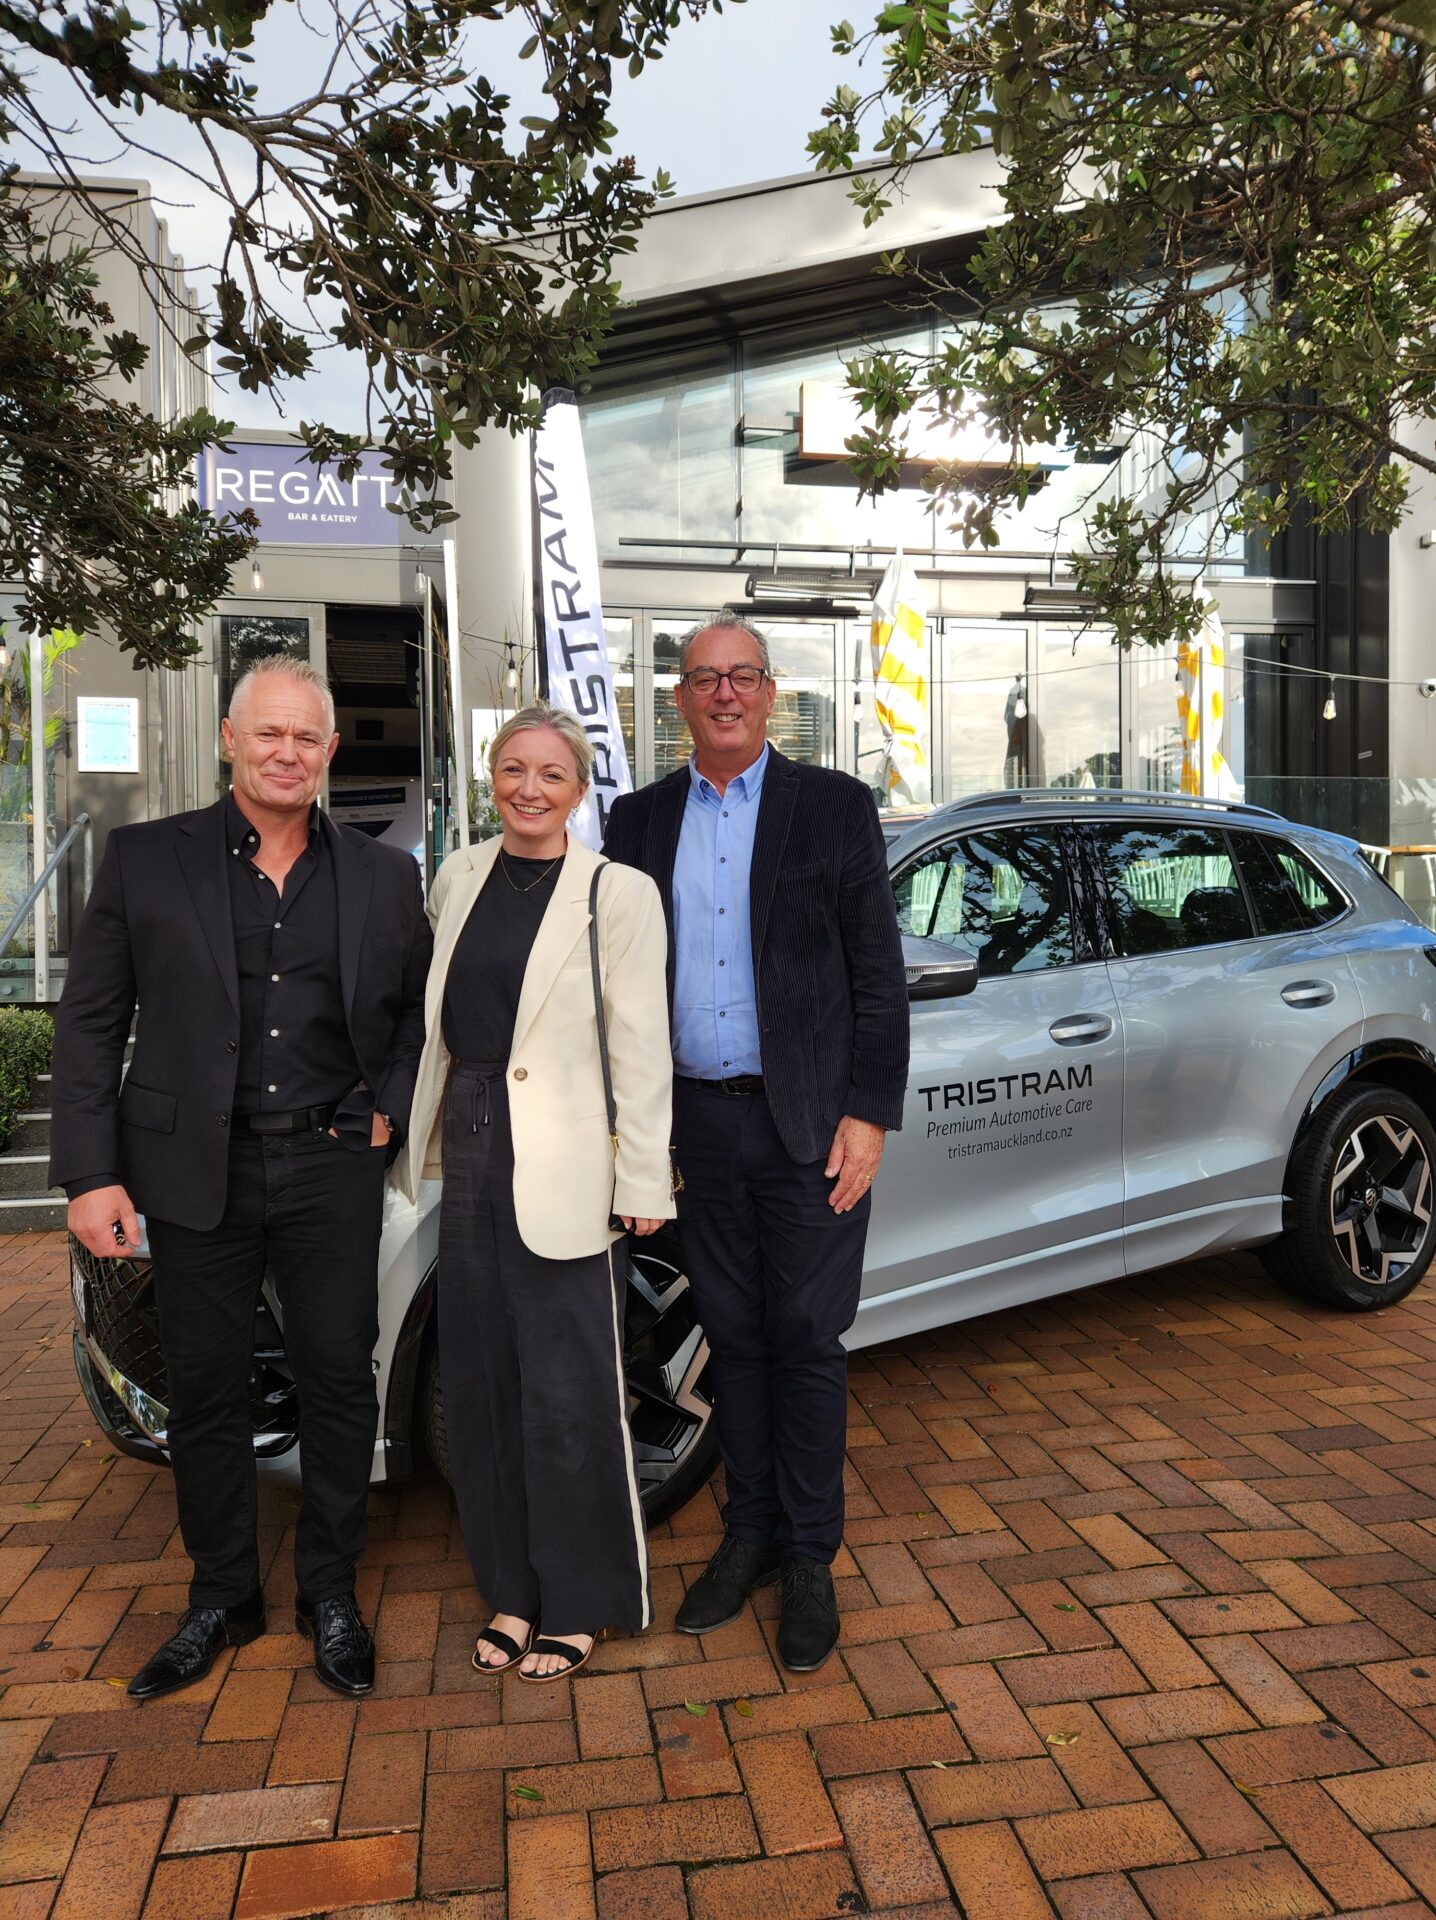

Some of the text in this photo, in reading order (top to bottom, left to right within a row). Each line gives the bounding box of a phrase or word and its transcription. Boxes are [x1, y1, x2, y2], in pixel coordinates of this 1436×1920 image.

[287, 512, 358, 524] BAR & EATERY
[918, 1064, 1093, 1112] TRISTRAM
[927, 1098, 1093, 1139] Premium Automotive Care
[948, 1126, 1073, 1159] tristramauckland.co.nz
